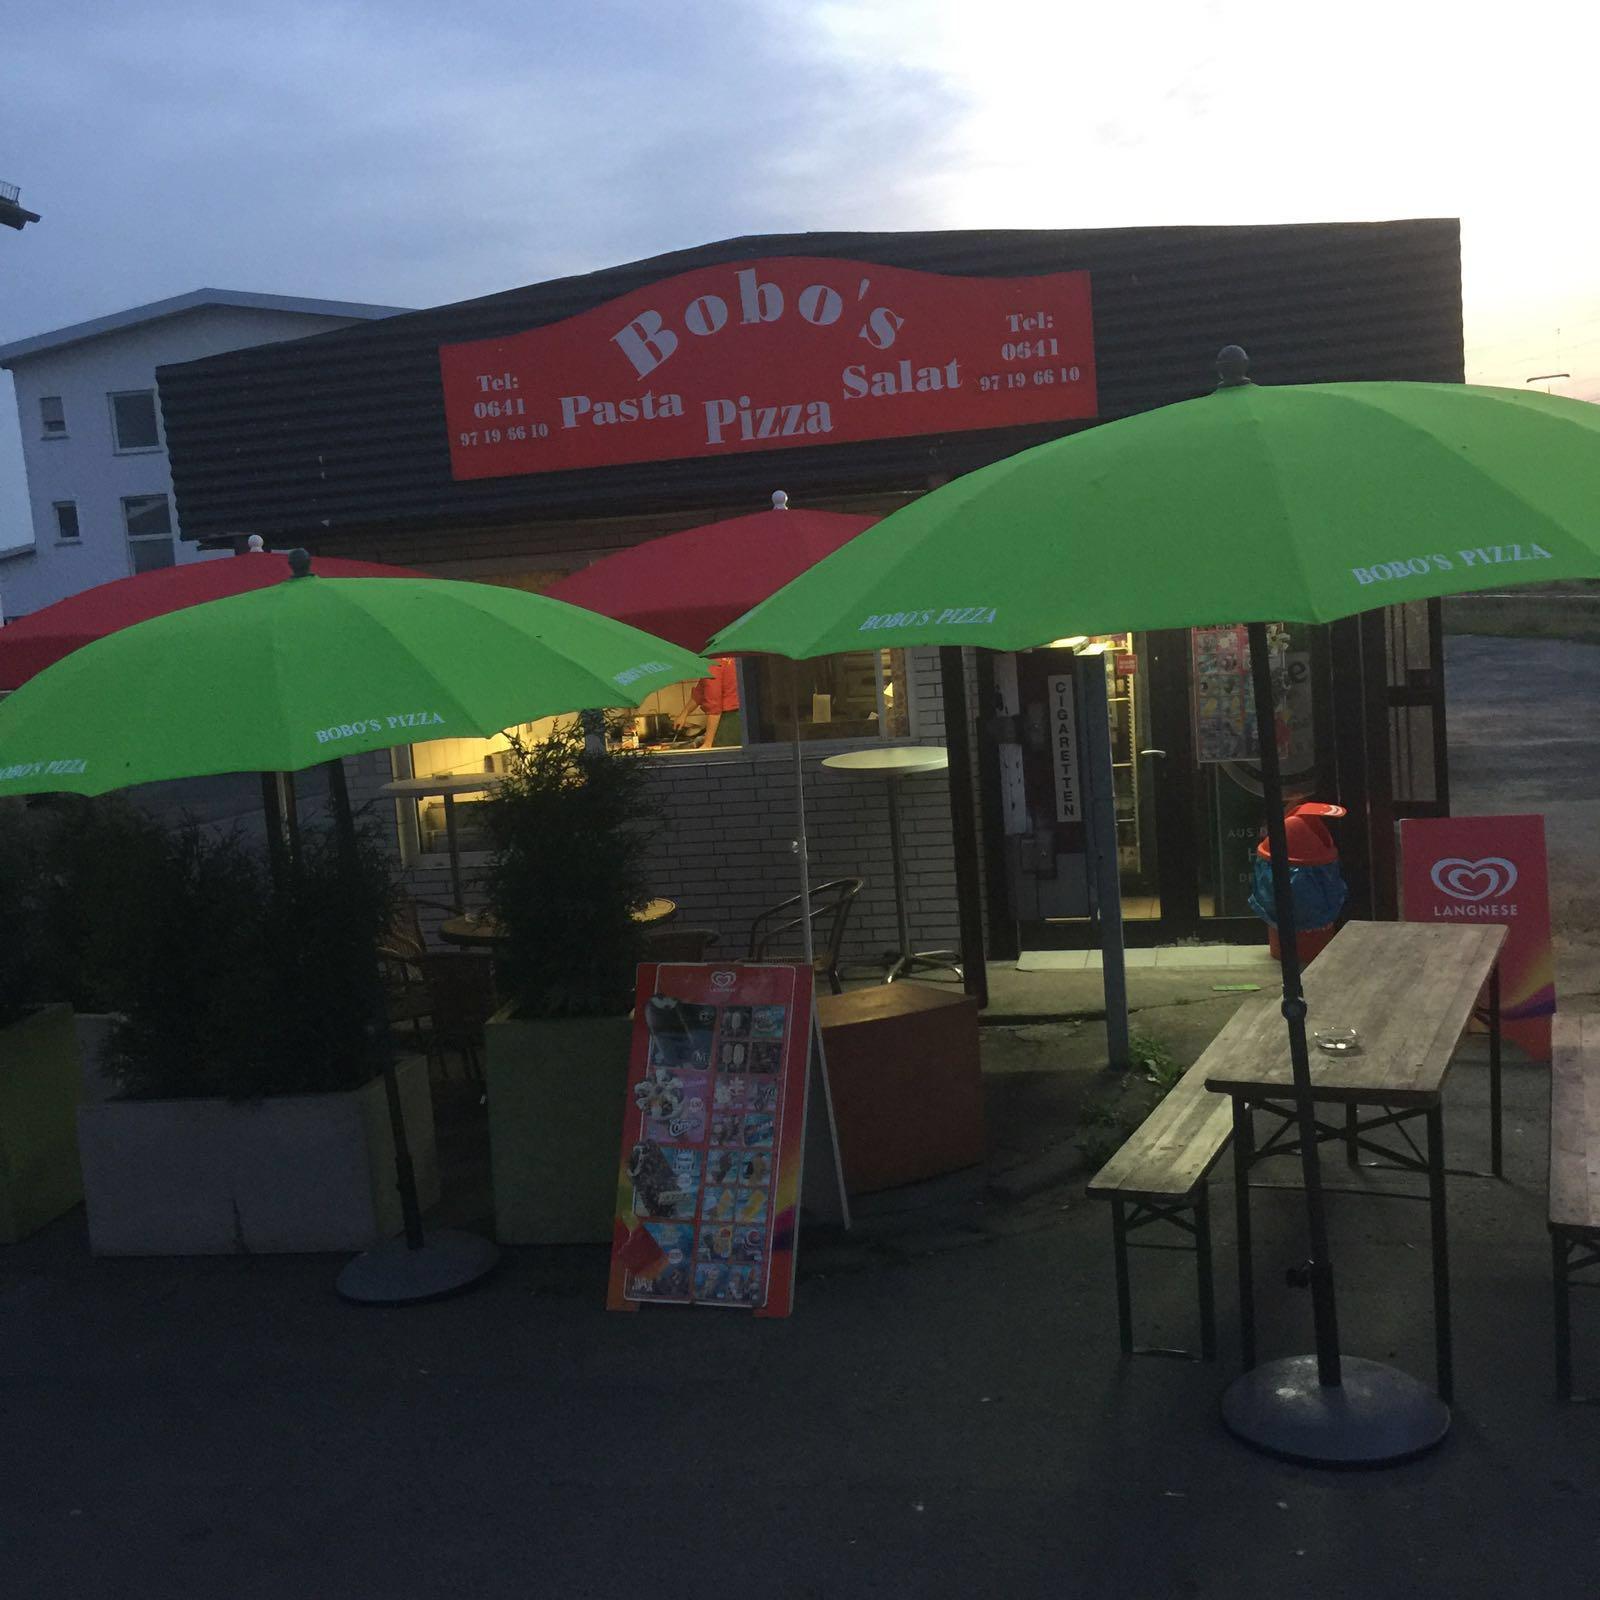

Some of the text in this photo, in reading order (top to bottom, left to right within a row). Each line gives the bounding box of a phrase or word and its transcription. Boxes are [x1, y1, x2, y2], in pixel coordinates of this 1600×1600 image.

[609, 268, 905, 382] Bobo's
[1005, 311, 1054, 332] Tel:
[1001, 338, 1058, 361] 0641
[476, 373, 519, 392] Tel:
[841, 358, 962, 401] Salat
[980, 366, 1080, 391] 97 19 66 10
[473, 398, 526, 419] 0641
[559, 389, 686, 430] Pasta
[703, 396, 834, 446] Pizza
[460, 423, 549, 447] 97 19 66 10
[1352, 543, 1552, 585] BOBO'S PIZZA
[858, 607, 998, 632] BOBO'S PIZZA
[315, 712, 446, 744] BOBO'S PIZZA
[1055, 682, 1074, 816] CIGARETTEN
[1433, 904, 1519, 917] LANGNESE
